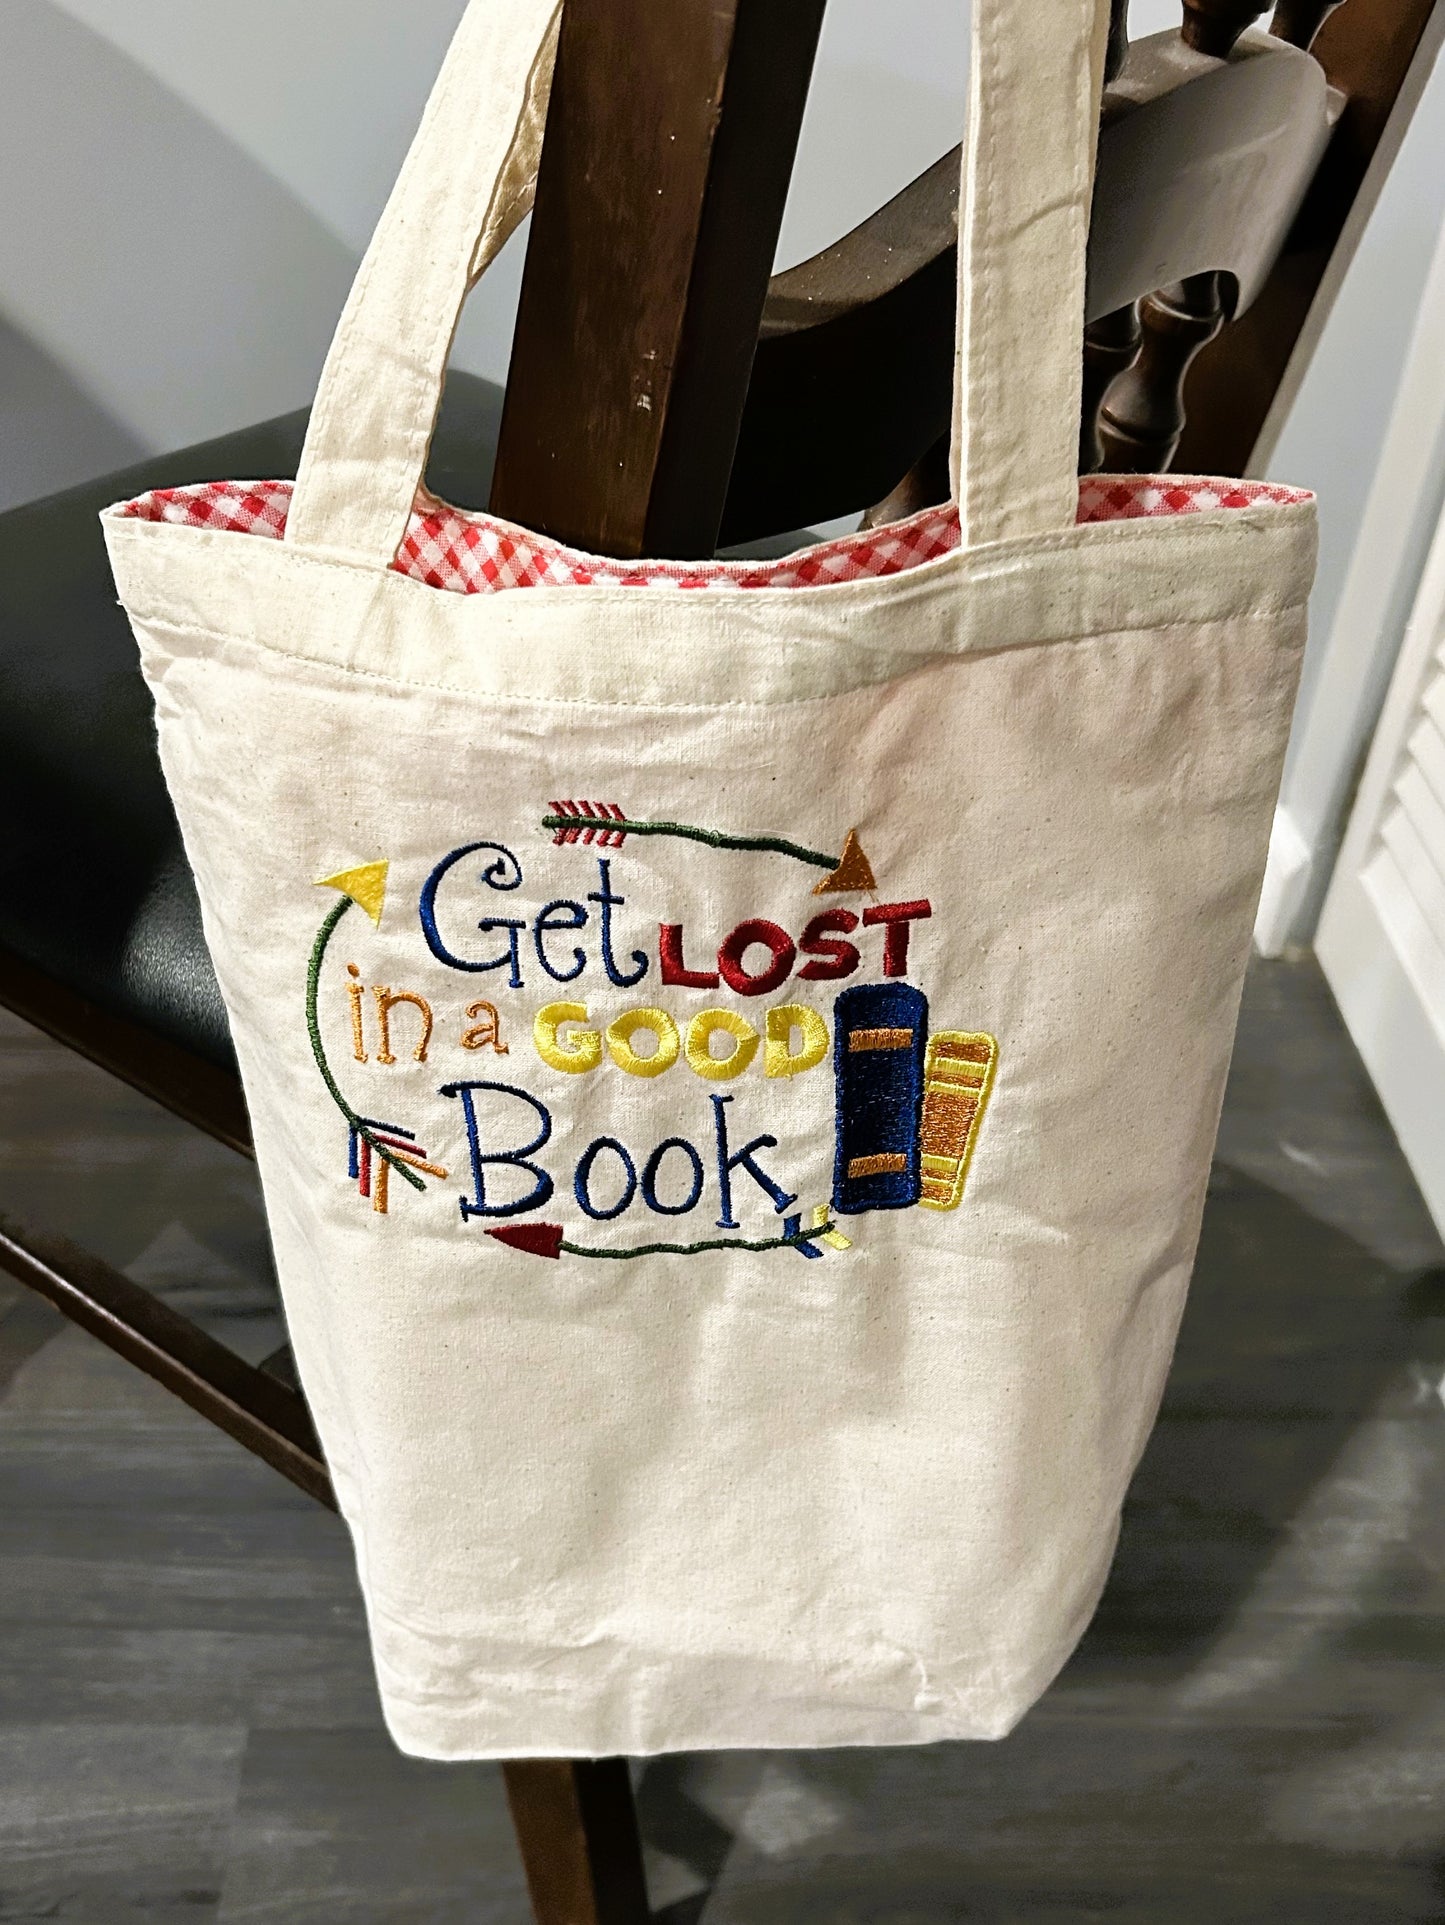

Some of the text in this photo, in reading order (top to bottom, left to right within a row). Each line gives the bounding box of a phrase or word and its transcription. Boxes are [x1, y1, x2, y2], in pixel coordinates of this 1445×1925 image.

[420, 841, 932, 996] Get LOST
[345, 962, 829, 1081] in a GOOD
[437, 1080, 798, 1229] Book
